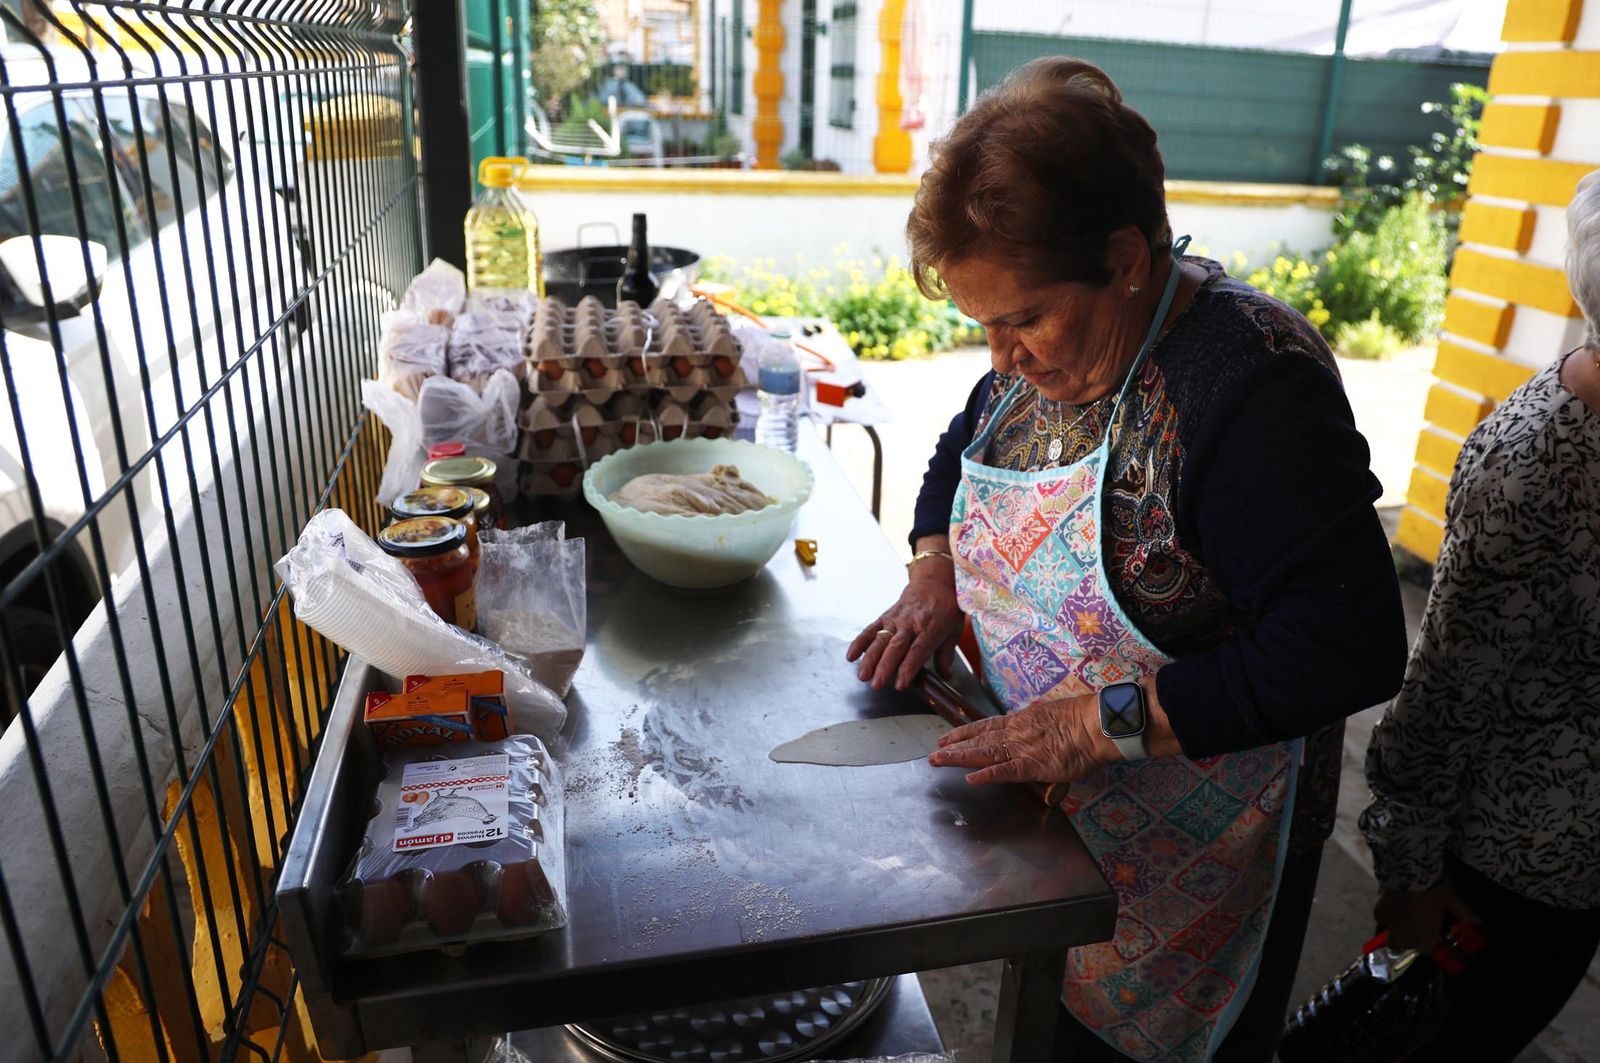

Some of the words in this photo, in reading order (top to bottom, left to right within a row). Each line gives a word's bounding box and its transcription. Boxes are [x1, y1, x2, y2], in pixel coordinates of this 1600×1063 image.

[387, 726, 455, 743] ROYAL
[486, 827, 503, 837] 12
[399, 834, 440, 847] jamón
